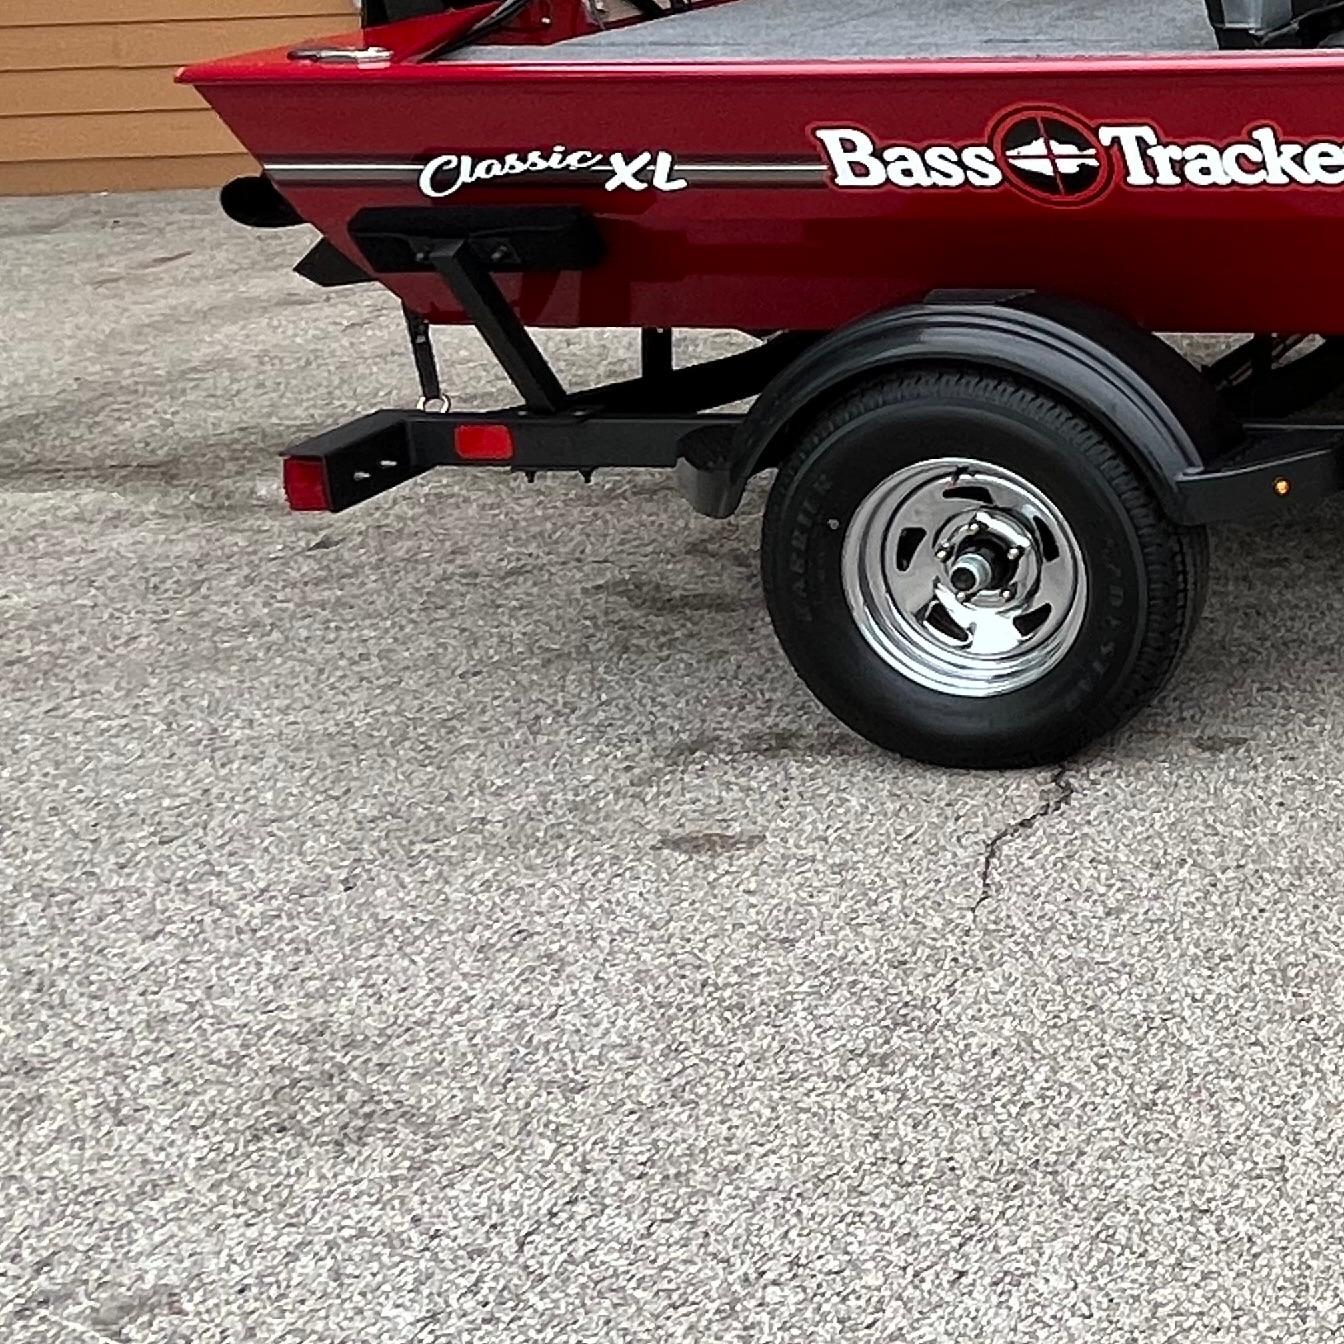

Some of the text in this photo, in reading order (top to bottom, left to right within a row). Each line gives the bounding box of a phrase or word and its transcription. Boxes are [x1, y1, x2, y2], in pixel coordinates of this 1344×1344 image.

[419, 145, 687, 197] Classic XL
[815, 128, 1003, 187] Bass
